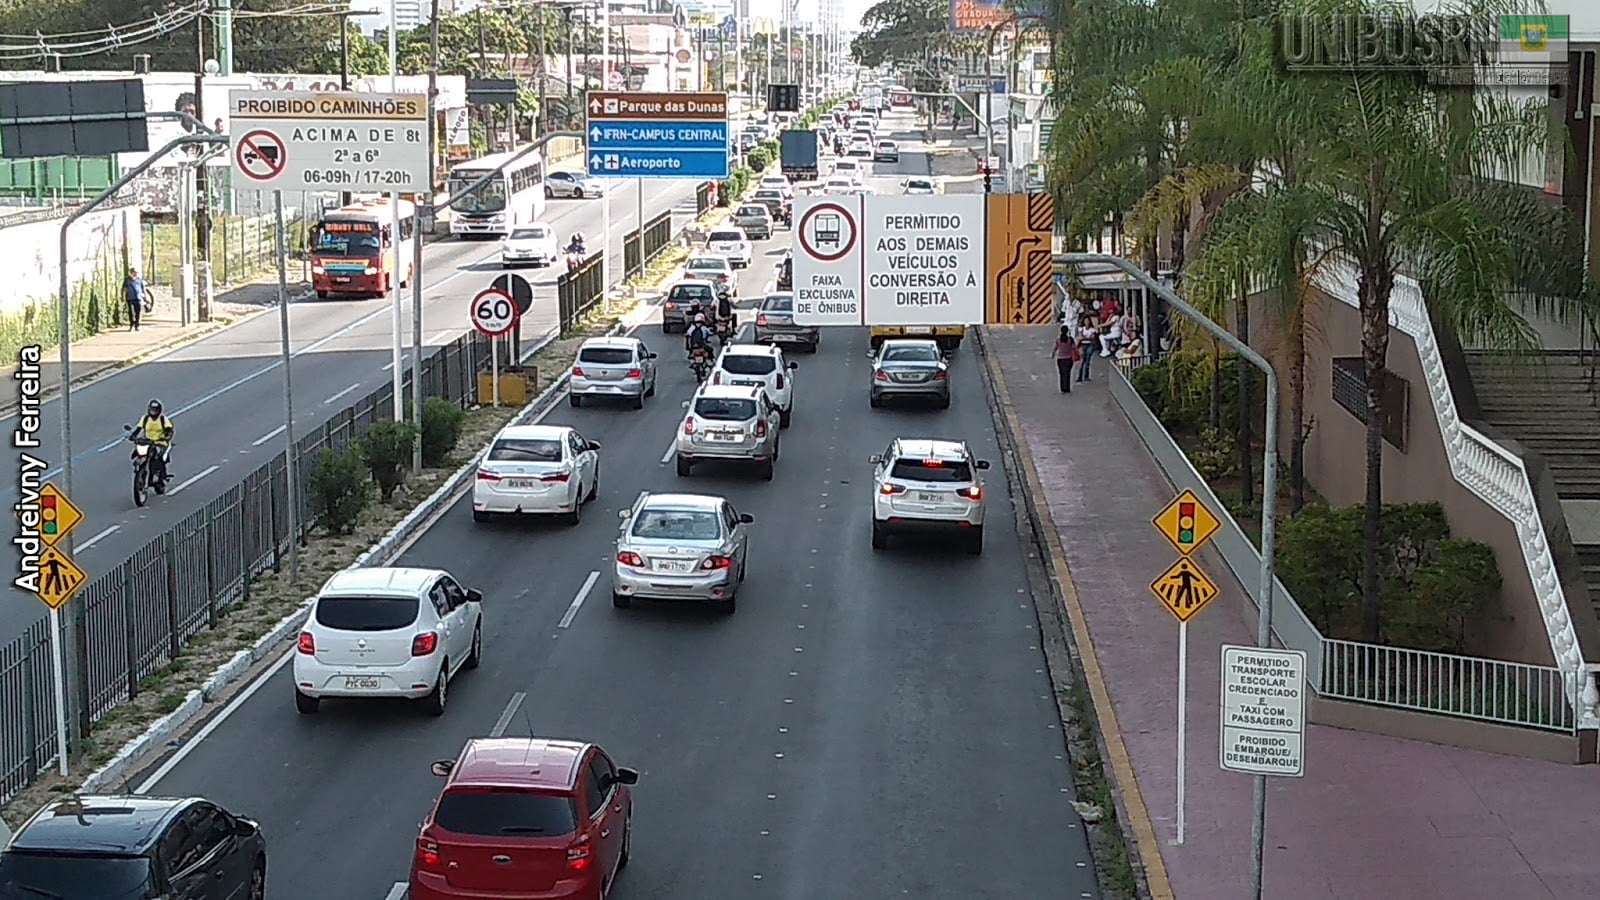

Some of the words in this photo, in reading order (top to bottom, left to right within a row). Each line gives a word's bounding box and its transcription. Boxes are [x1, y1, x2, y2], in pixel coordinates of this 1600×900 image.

[238, 99, 316, 113] PROIBIDO
[320, 98, 418, 115] CAMINHÕES
[620, 101, 662, 114] Parque
[664, 100, 686, 112] das
[688, 101, 725, 112] Dunas
[292, 128, 358, 142] ACIMA
[369, 129, 394, 142] DE
[406, 130, 420, 142] 8t
[603, 128, 676, 140] IFRN-CAMPUS
[678, 129, 725, 141] CENTRAL
[334, 149, 348, 162] 2ª
[352, 152, 361, 162] a
[365, 149, 379, 163] 6ª
[620, 156, 681, 170] Aeroporto
[304, 170, 351, 183] 06-09h
[355, 170, 360, 183] /
[364, 171, 411, 184] 17-20h
[885, 215, 961, 230] PERMITIDO
[876, 238, 907, 251] AOS
[916, 237, 969, 251] DEMAIS
[888, 253, 958, 269] VEÍCULOS
[812, 275, 842, 286] FAIXA
[870, 272, 957, 287] CONVERSÃO
[965, 270, 977, 287] À
[799, 289, 856, 300] EXCLUSIVA
[896, 292, 950, 306] DIREITA
[477, 300, 510, 320] 60
[797, 303, 812, 313] DE
[818, 301, 857, 314] ÔNIBUS
[1237, 656, 1290, 668] PERMITIDO
[1231, 665, 1296, 678] TRANSPORTE
[1240, 676, 1286, 687] ESCOLAR
[1229, 684, 1298, 698] CREDENCIADO
[1259, 697, 1266, 706] E
[1240, 705, 1261, 715] TAXI
[1262, 706, 1285, 716] COM
[1231, 714, 1294, 727] PASSAGEIRO
[1239, 735, 1286, 747] PROIBIDO
[1226, 753, 1299, 768] DESEMBARQUE
